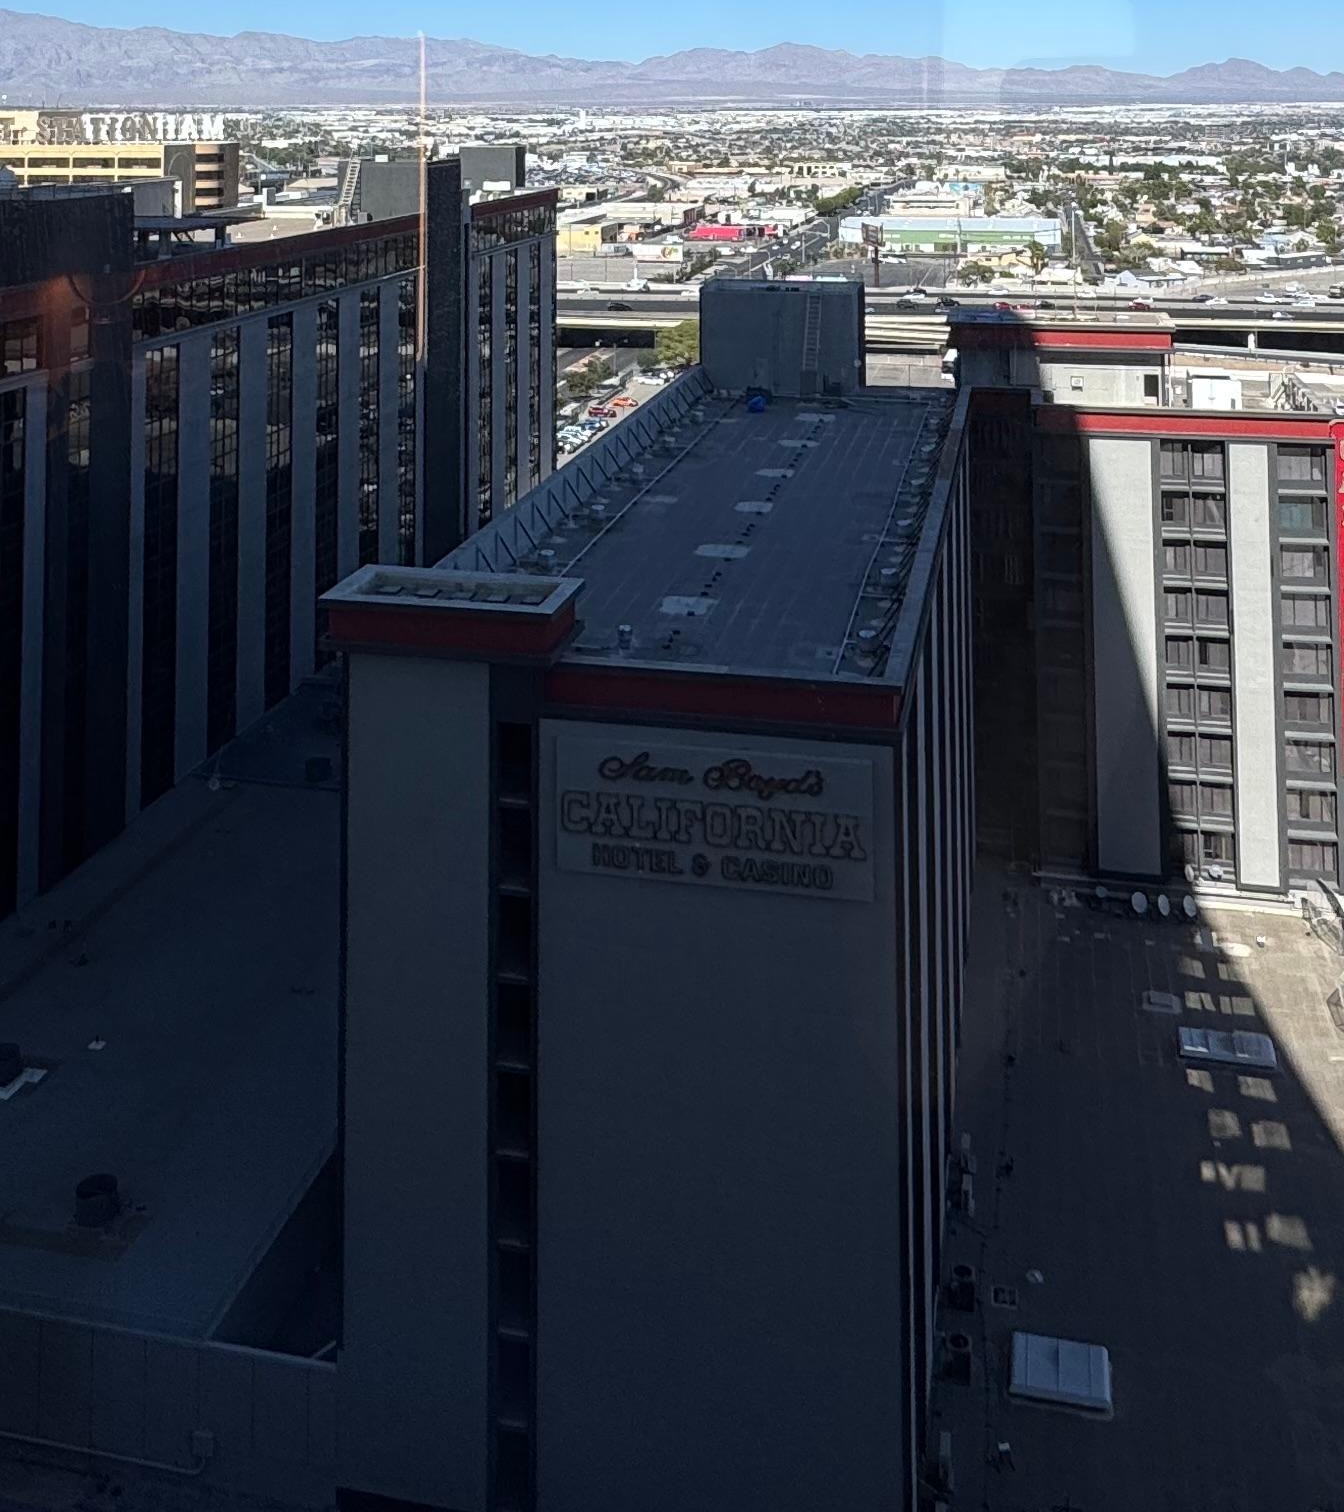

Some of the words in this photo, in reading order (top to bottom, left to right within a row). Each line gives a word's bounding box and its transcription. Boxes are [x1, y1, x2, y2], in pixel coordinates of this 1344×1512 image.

[36, 115, 158, 145] STATION
[598, 751, 694, 786] Sam
[703, 757, 825, 800] Boyd's
[560, 790, 867, 861] CALIFORNIA
[592, 842, 684, 875] HOTEL
[691, 853, 712, 877] &
[720, 855, 834, 890] CASINO
